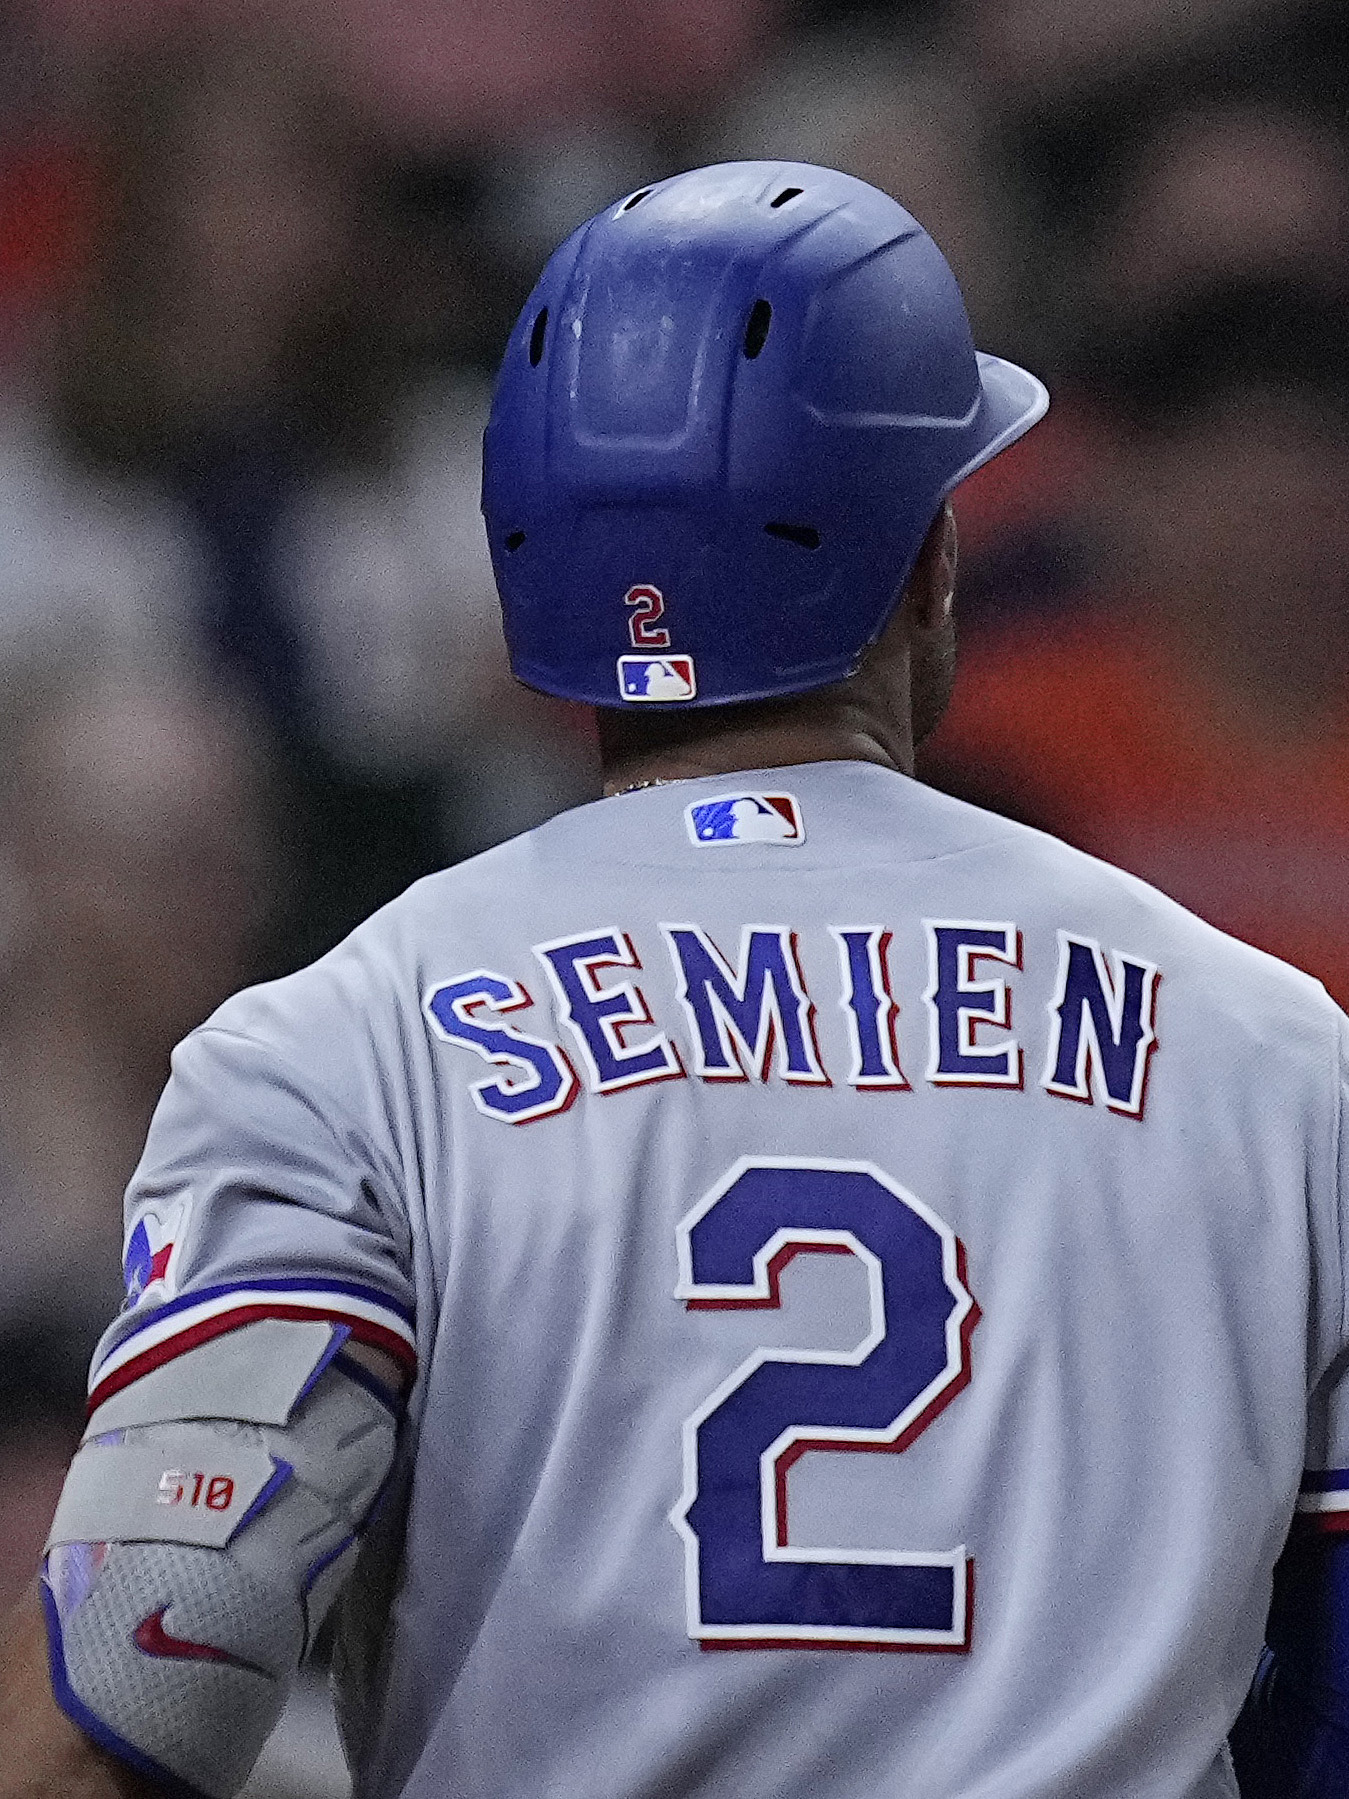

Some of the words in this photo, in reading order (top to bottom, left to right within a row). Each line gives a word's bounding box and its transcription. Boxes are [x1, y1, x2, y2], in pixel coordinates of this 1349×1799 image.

[624, 584, 671, 648] 2
[422, 919, 1162, 1124] SEMIEN
[669, 1155, 982, 1653] 2
